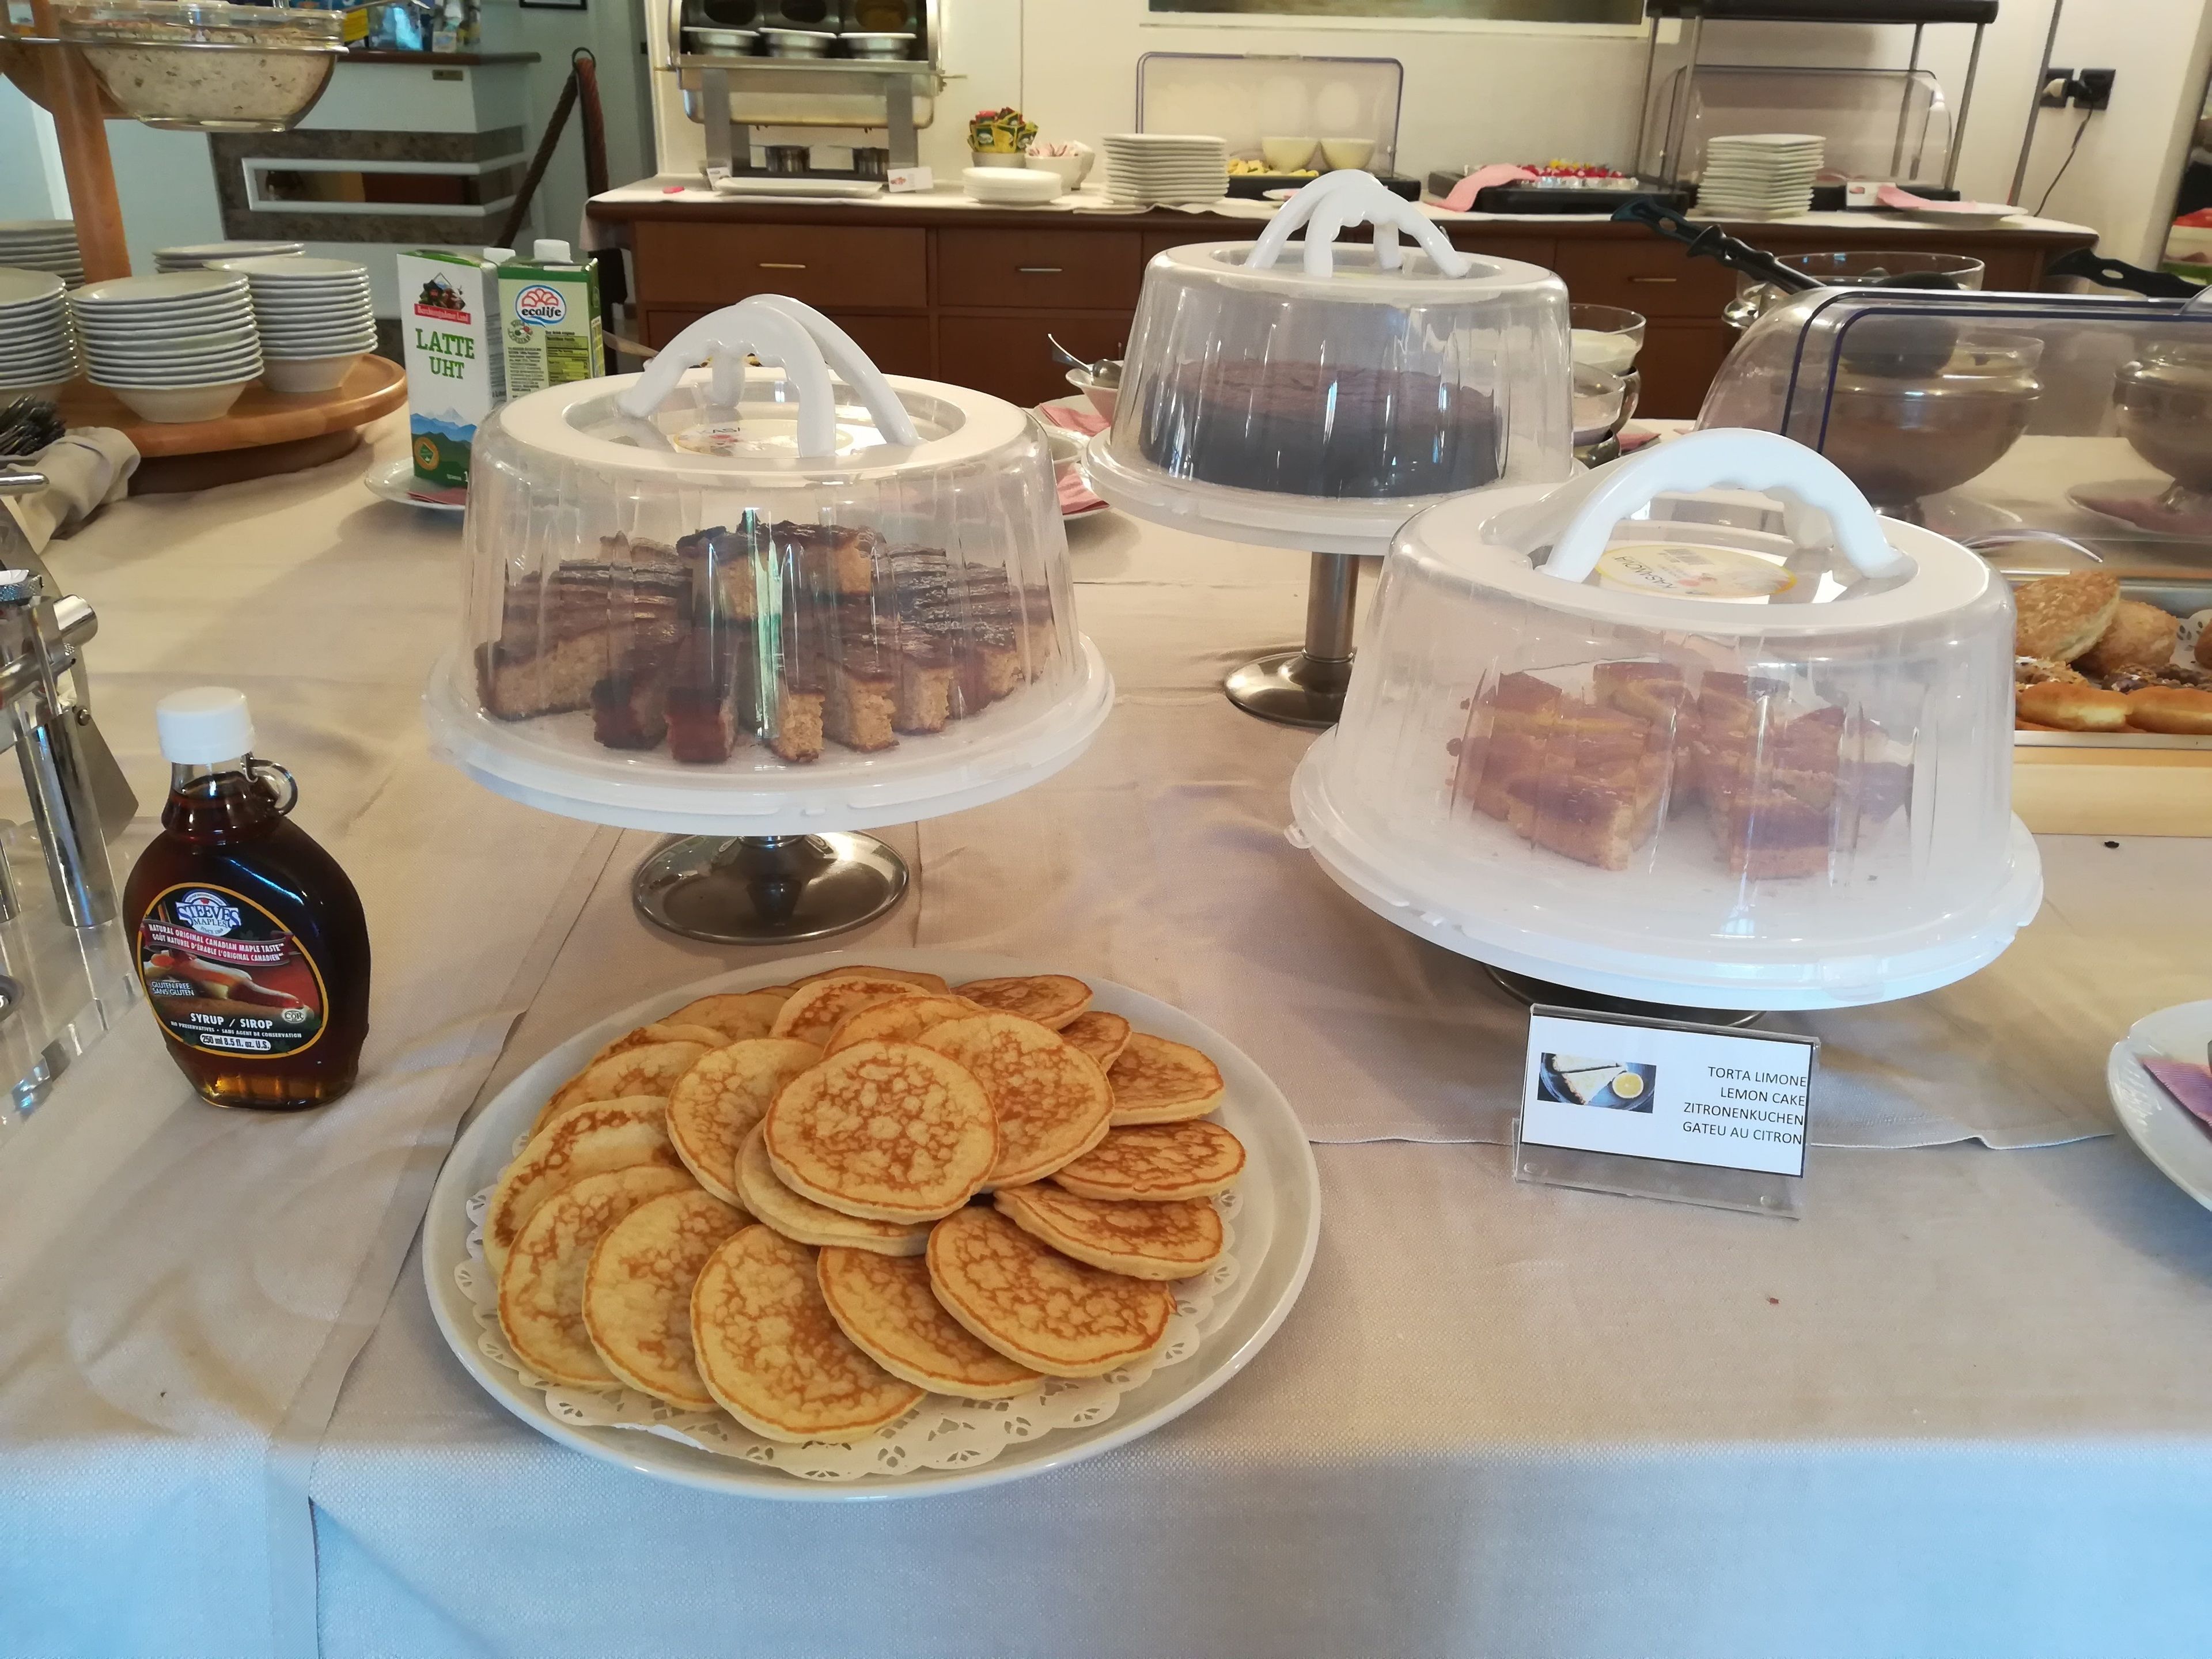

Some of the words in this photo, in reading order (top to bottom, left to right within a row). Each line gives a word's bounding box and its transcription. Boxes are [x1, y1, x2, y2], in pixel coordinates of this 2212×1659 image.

[521, 306, 562, 318] ecolife
[415, 328, 475, 359] LATTE
[429, 356, 464, 379] UHT
[177, 904, 240, 929] STEEVES
[194, 918, 228, 929] MAPLES
[149, 924, 174, 935] NATURAL
[175, 929, 204, 944] ORIGINAL
[205, 938, 237, 950] CANADIAN
[239, 945, 260, 953] MAPLE
[167, 935, 190, 948] NATUREL
[218, 949, 249, 961] L'ORIGINAL
[151, 981, 174, 989] GLUTEN
[179, 1022, 215, 1032] PRESERVATIVES
[190, 1013, 224, 1025] SYRUP
[229, 1018, 236, 1028] /
[240, 1018, 273, 1029] SIROP
[202, 1035, 214, 1044] 250
[215, 1037, 223, 1046] ml
[224, 1038, 235, 1046] 8.5
[256, 1040, 270, 1049] U.S.
[1708, 1066, 1751, 1081] TORTA
[1755, 1071, 1807, 1088] LIMONE
[1721, 1087, 1768, 1102] LEMON
[1772, 1093, 1805, 1107] CAKE
[1684, 1102, 1804, 1126] ZITRONENKUCHEN
[1683, 1122, 1726, 1136] GATEU
[1730, 1127, 1749, 1138] AU
[1753, 1129, 1802, 1145] CITRON
